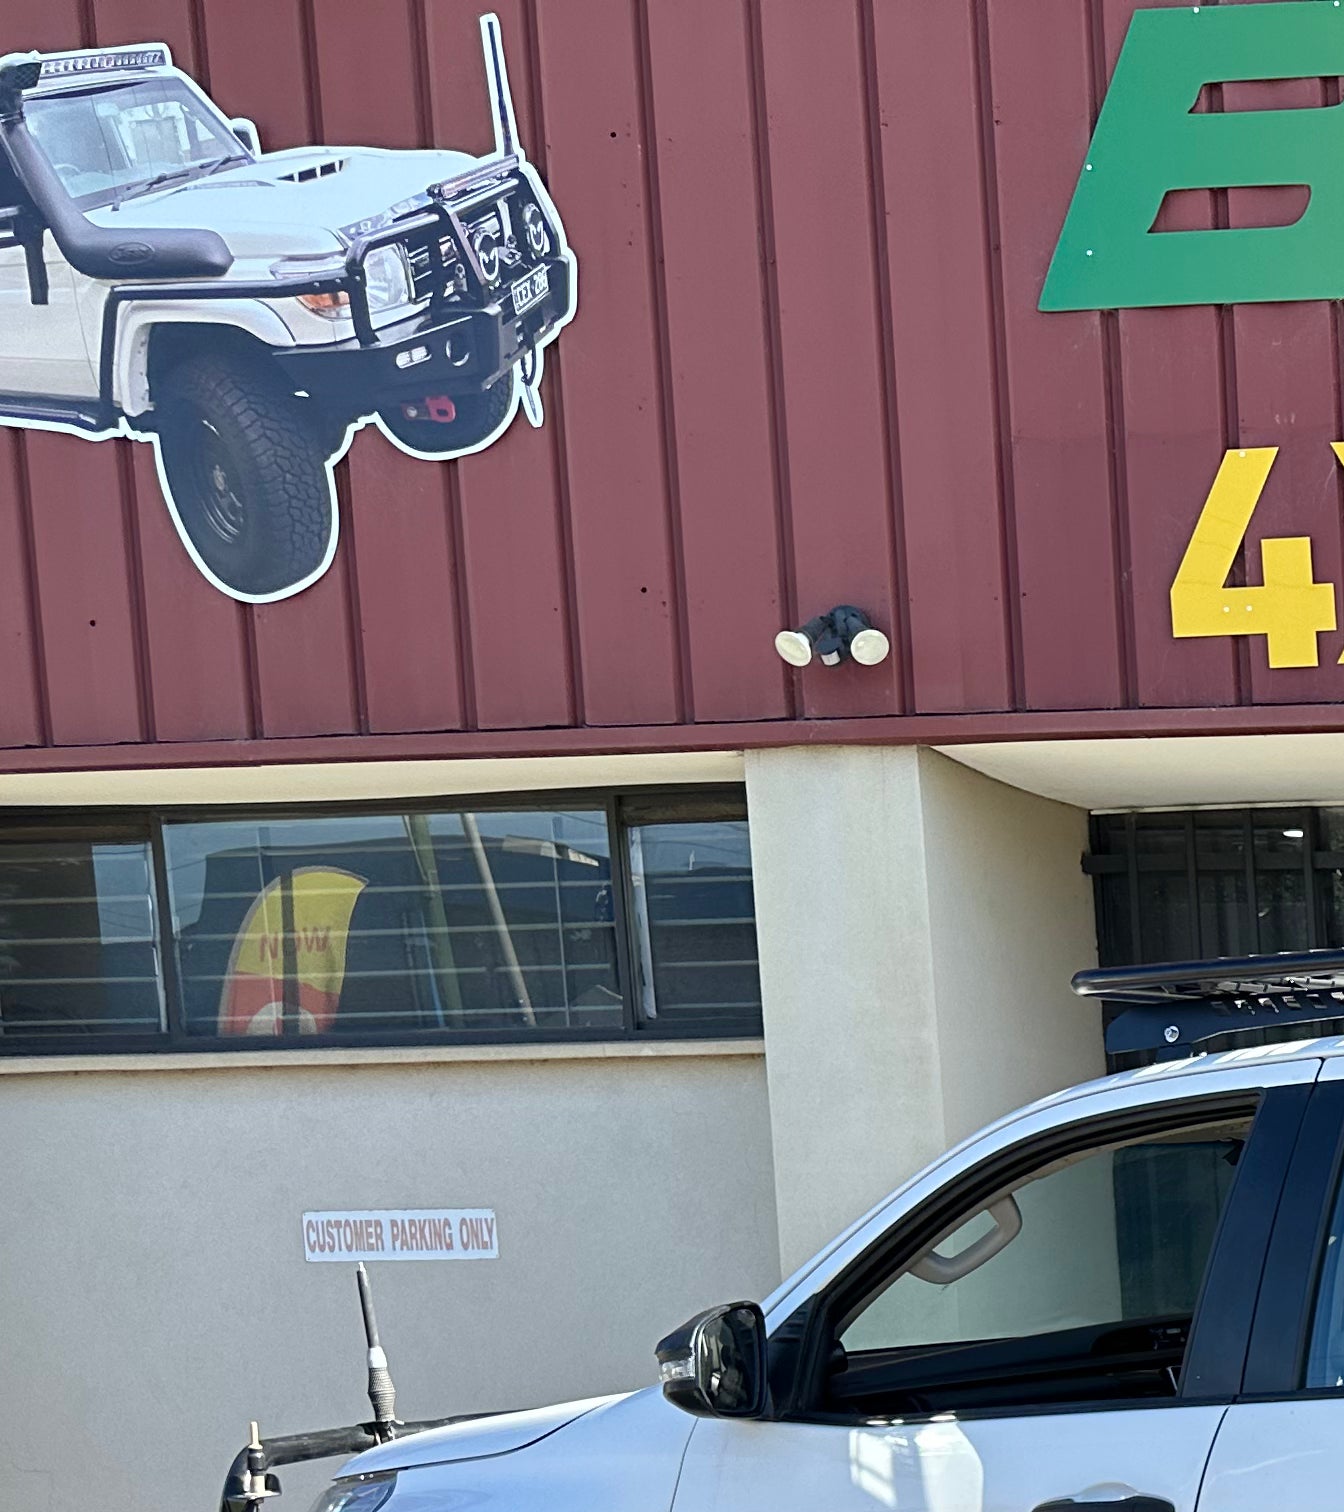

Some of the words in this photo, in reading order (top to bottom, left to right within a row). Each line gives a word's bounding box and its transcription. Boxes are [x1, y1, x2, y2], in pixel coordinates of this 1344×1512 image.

[259, 926, 331, 963] NW
[306, 1218, 385, 1253] CUSTOMER
[389, 1216, 454, 1251] PARKING
[459, 1216, 495, 1251] ONLY
